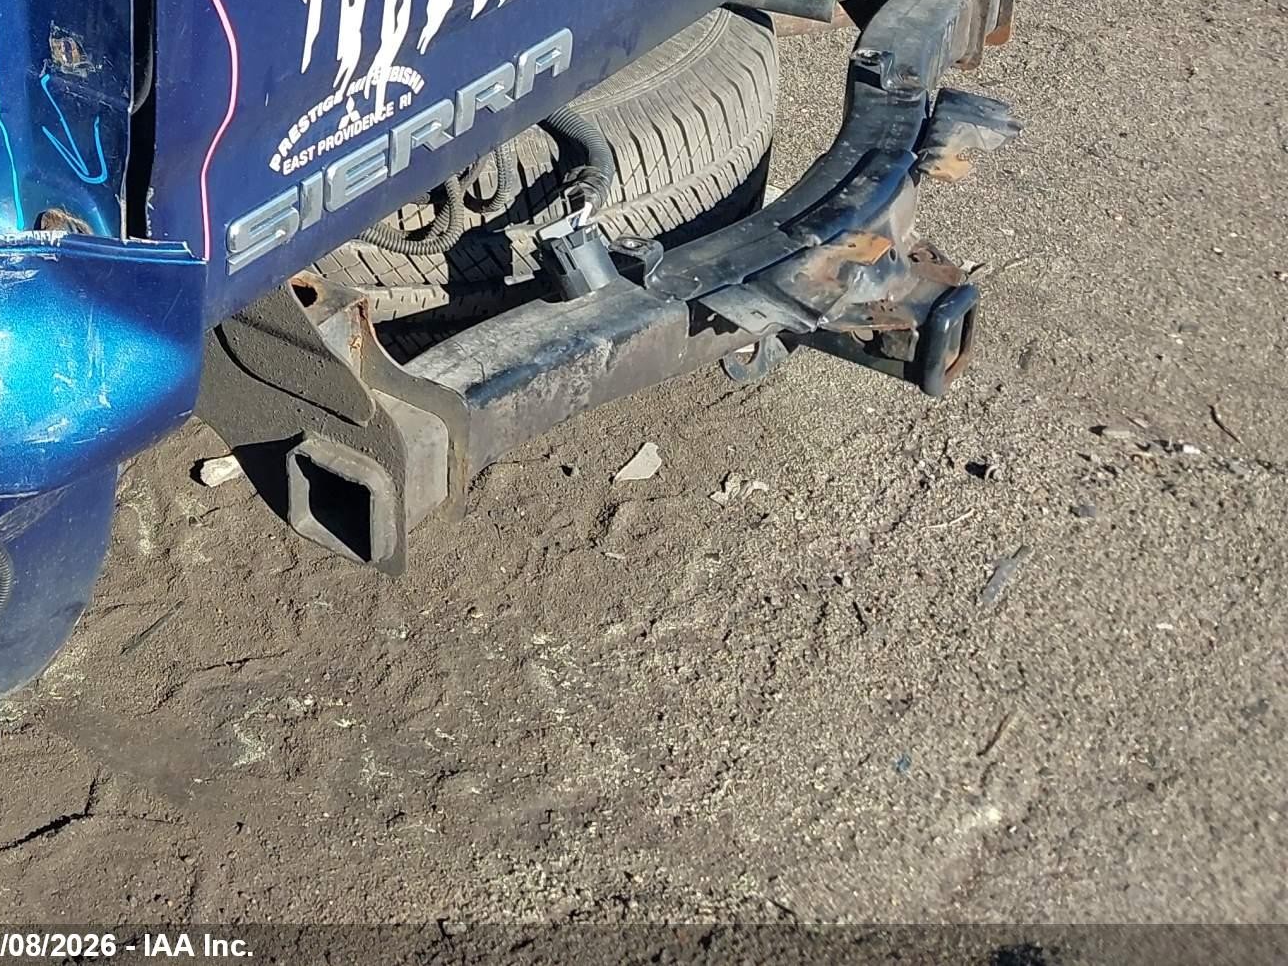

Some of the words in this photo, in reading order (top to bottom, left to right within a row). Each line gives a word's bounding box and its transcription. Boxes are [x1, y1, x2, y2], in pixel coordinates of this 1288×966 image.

[226, 27, 574, 276] SIERRA
[282, 145, 315, 176] EAST
[317, 101, 394, 156] PROVIDENCE
[399, 91, 412, 110] RI
